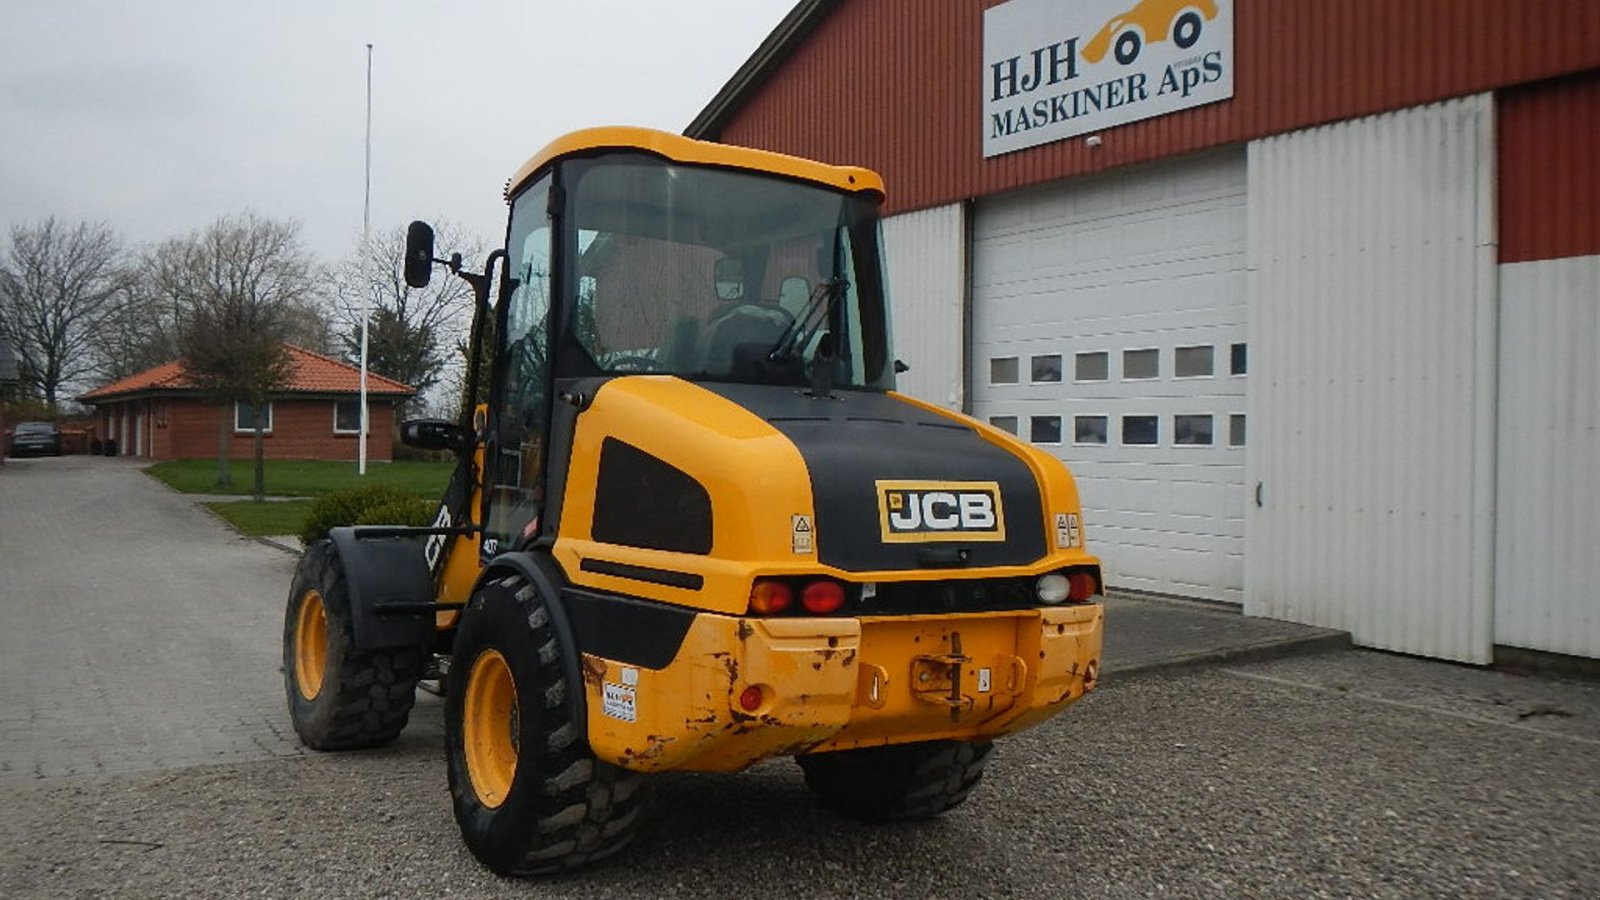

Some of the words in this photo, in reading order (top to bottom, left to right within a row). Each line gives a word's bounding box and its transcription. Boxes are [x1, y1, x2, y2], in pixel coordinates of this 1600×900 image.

[991, 37, 1079, 101] HJH
[991, 73, 1147, 138] MASKINER
[1157, 51, 1222, 97] ApS
[890, 492, 995, 529] JCB
